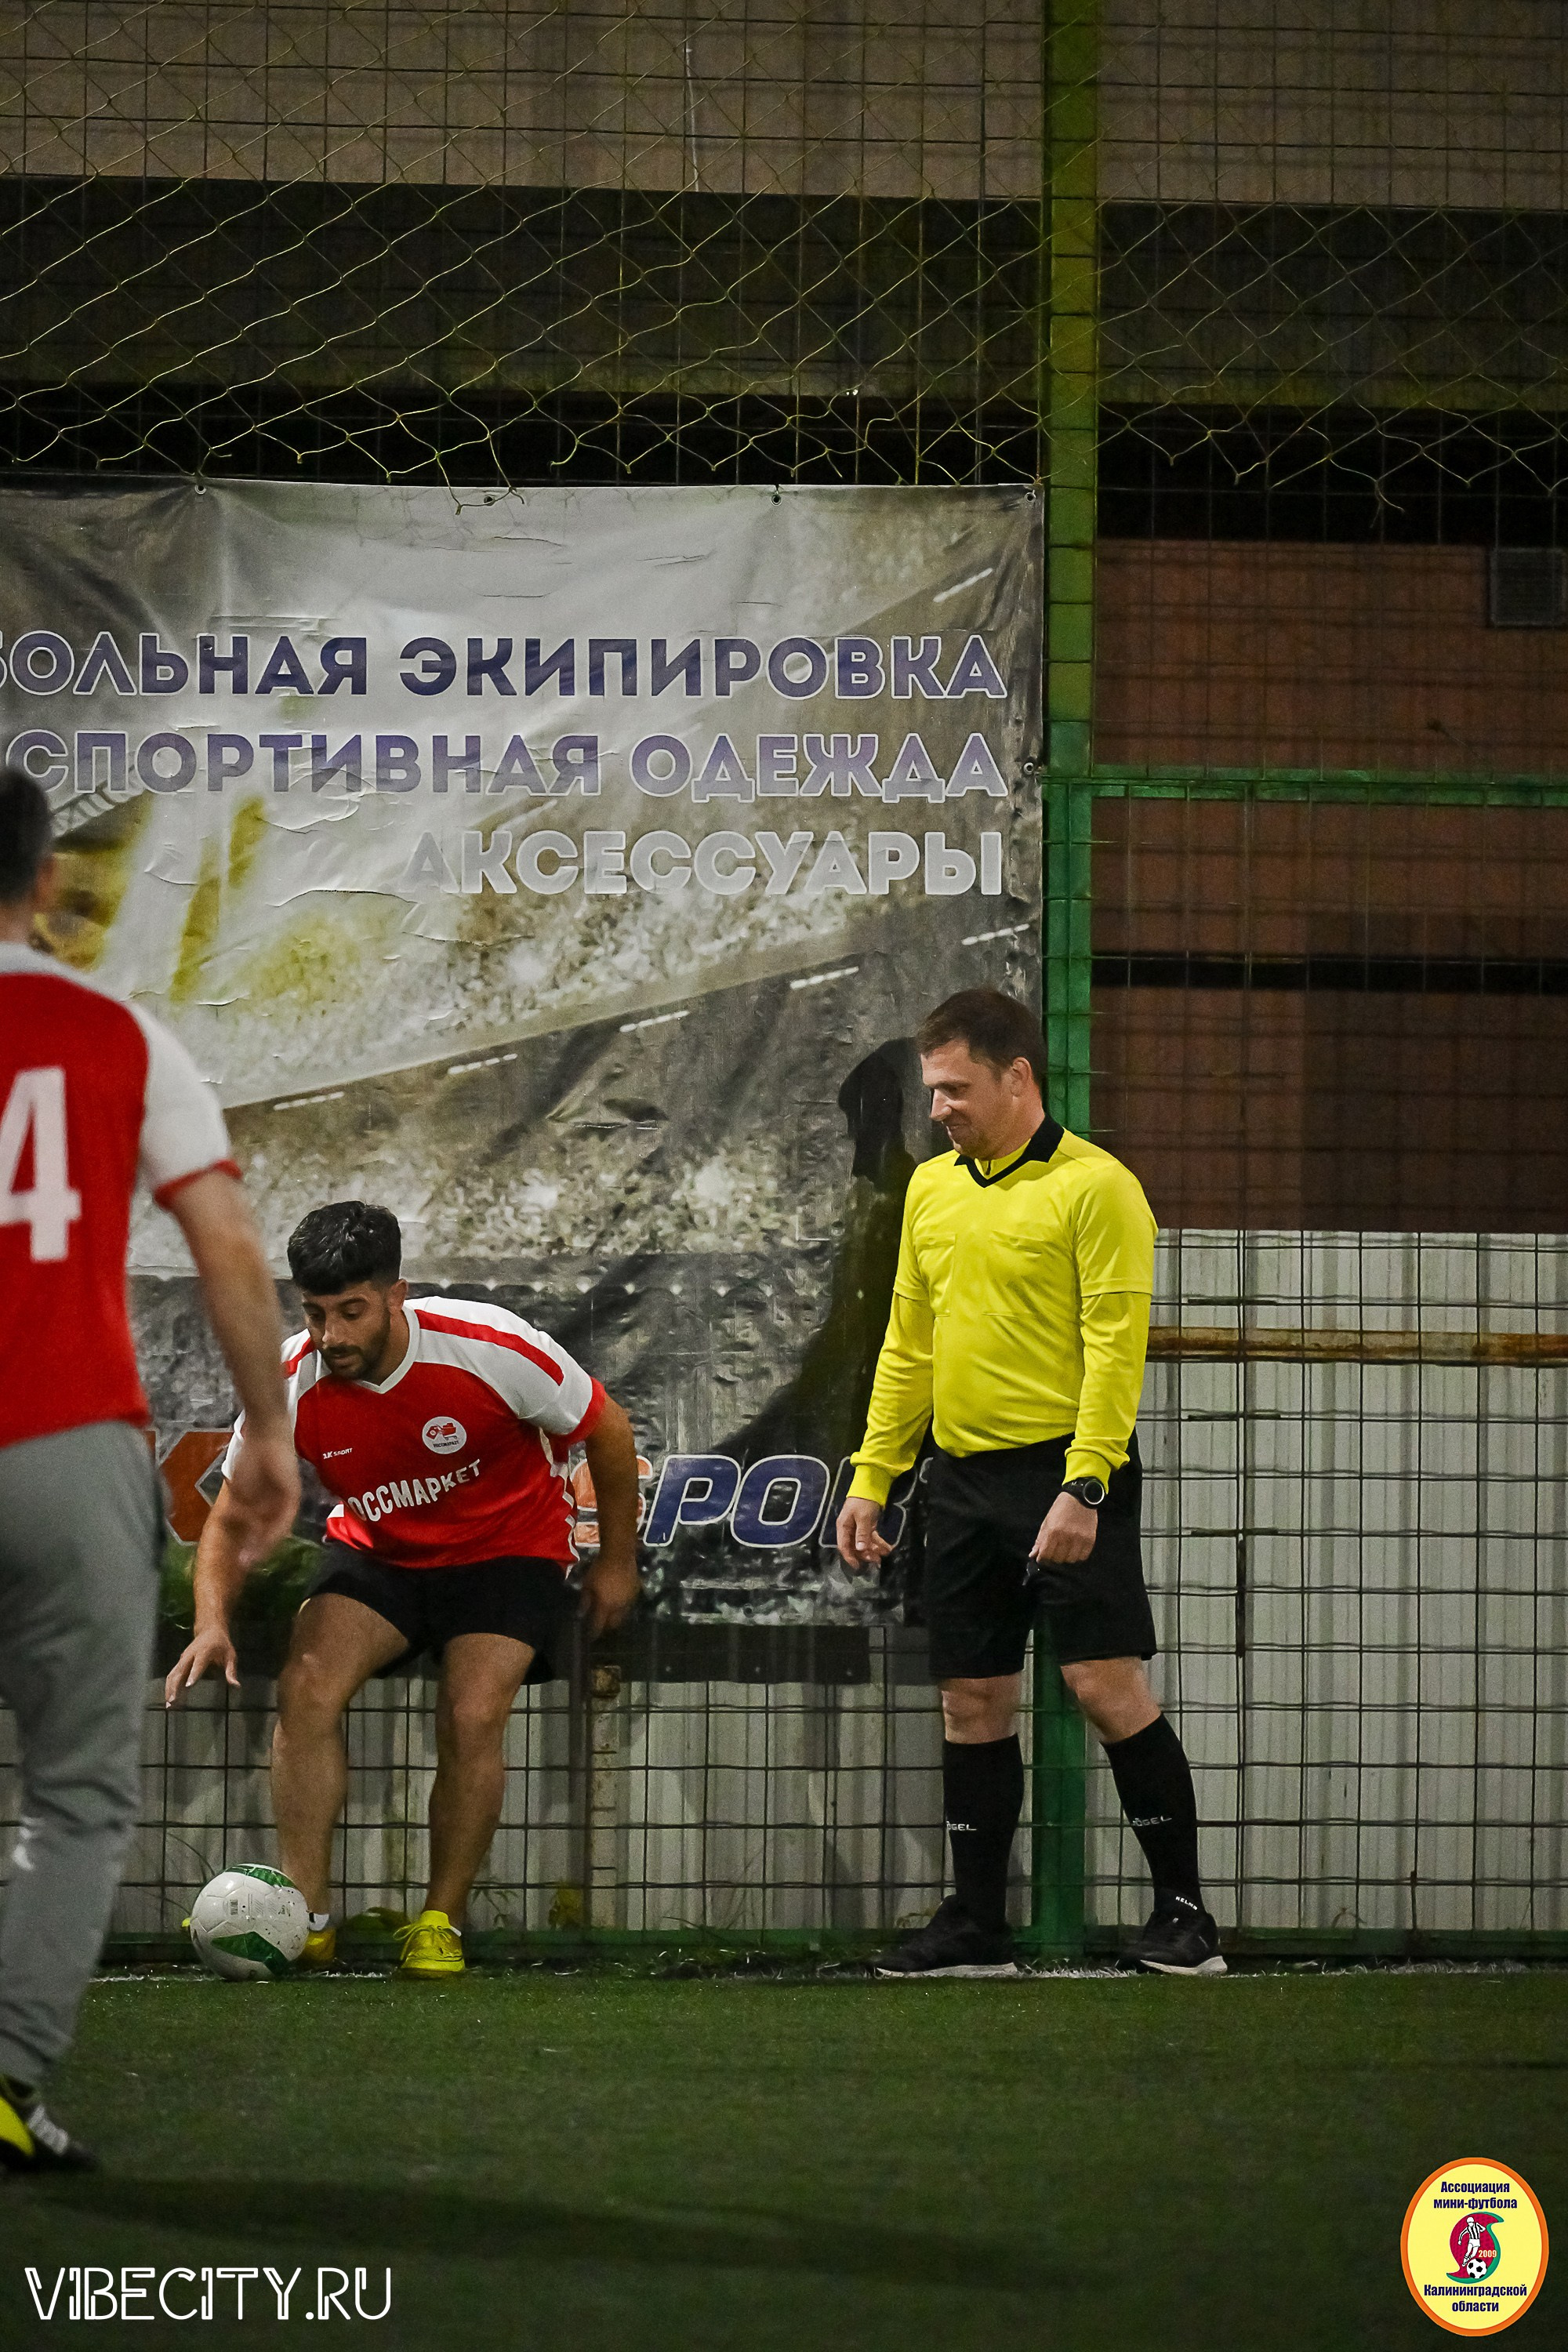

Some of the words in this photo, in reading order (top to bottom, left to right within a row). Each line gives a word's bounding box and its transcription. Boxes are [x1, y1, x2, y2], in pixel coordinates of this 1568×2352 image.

[0, 630, 368, 696] ОЛЬНАЯ
[398, 635, 1007, 699] ЭКИПИРОВКА
[6, 729, 601, 797] СПОРТИВНАЯ
[629, 733, 1008, 803] ОДЕЖДА
[408, 829, 1003, 895] АКСЕССУАРЫ
[347, 1458, 481, 1522] ОССМАРКЕТ
